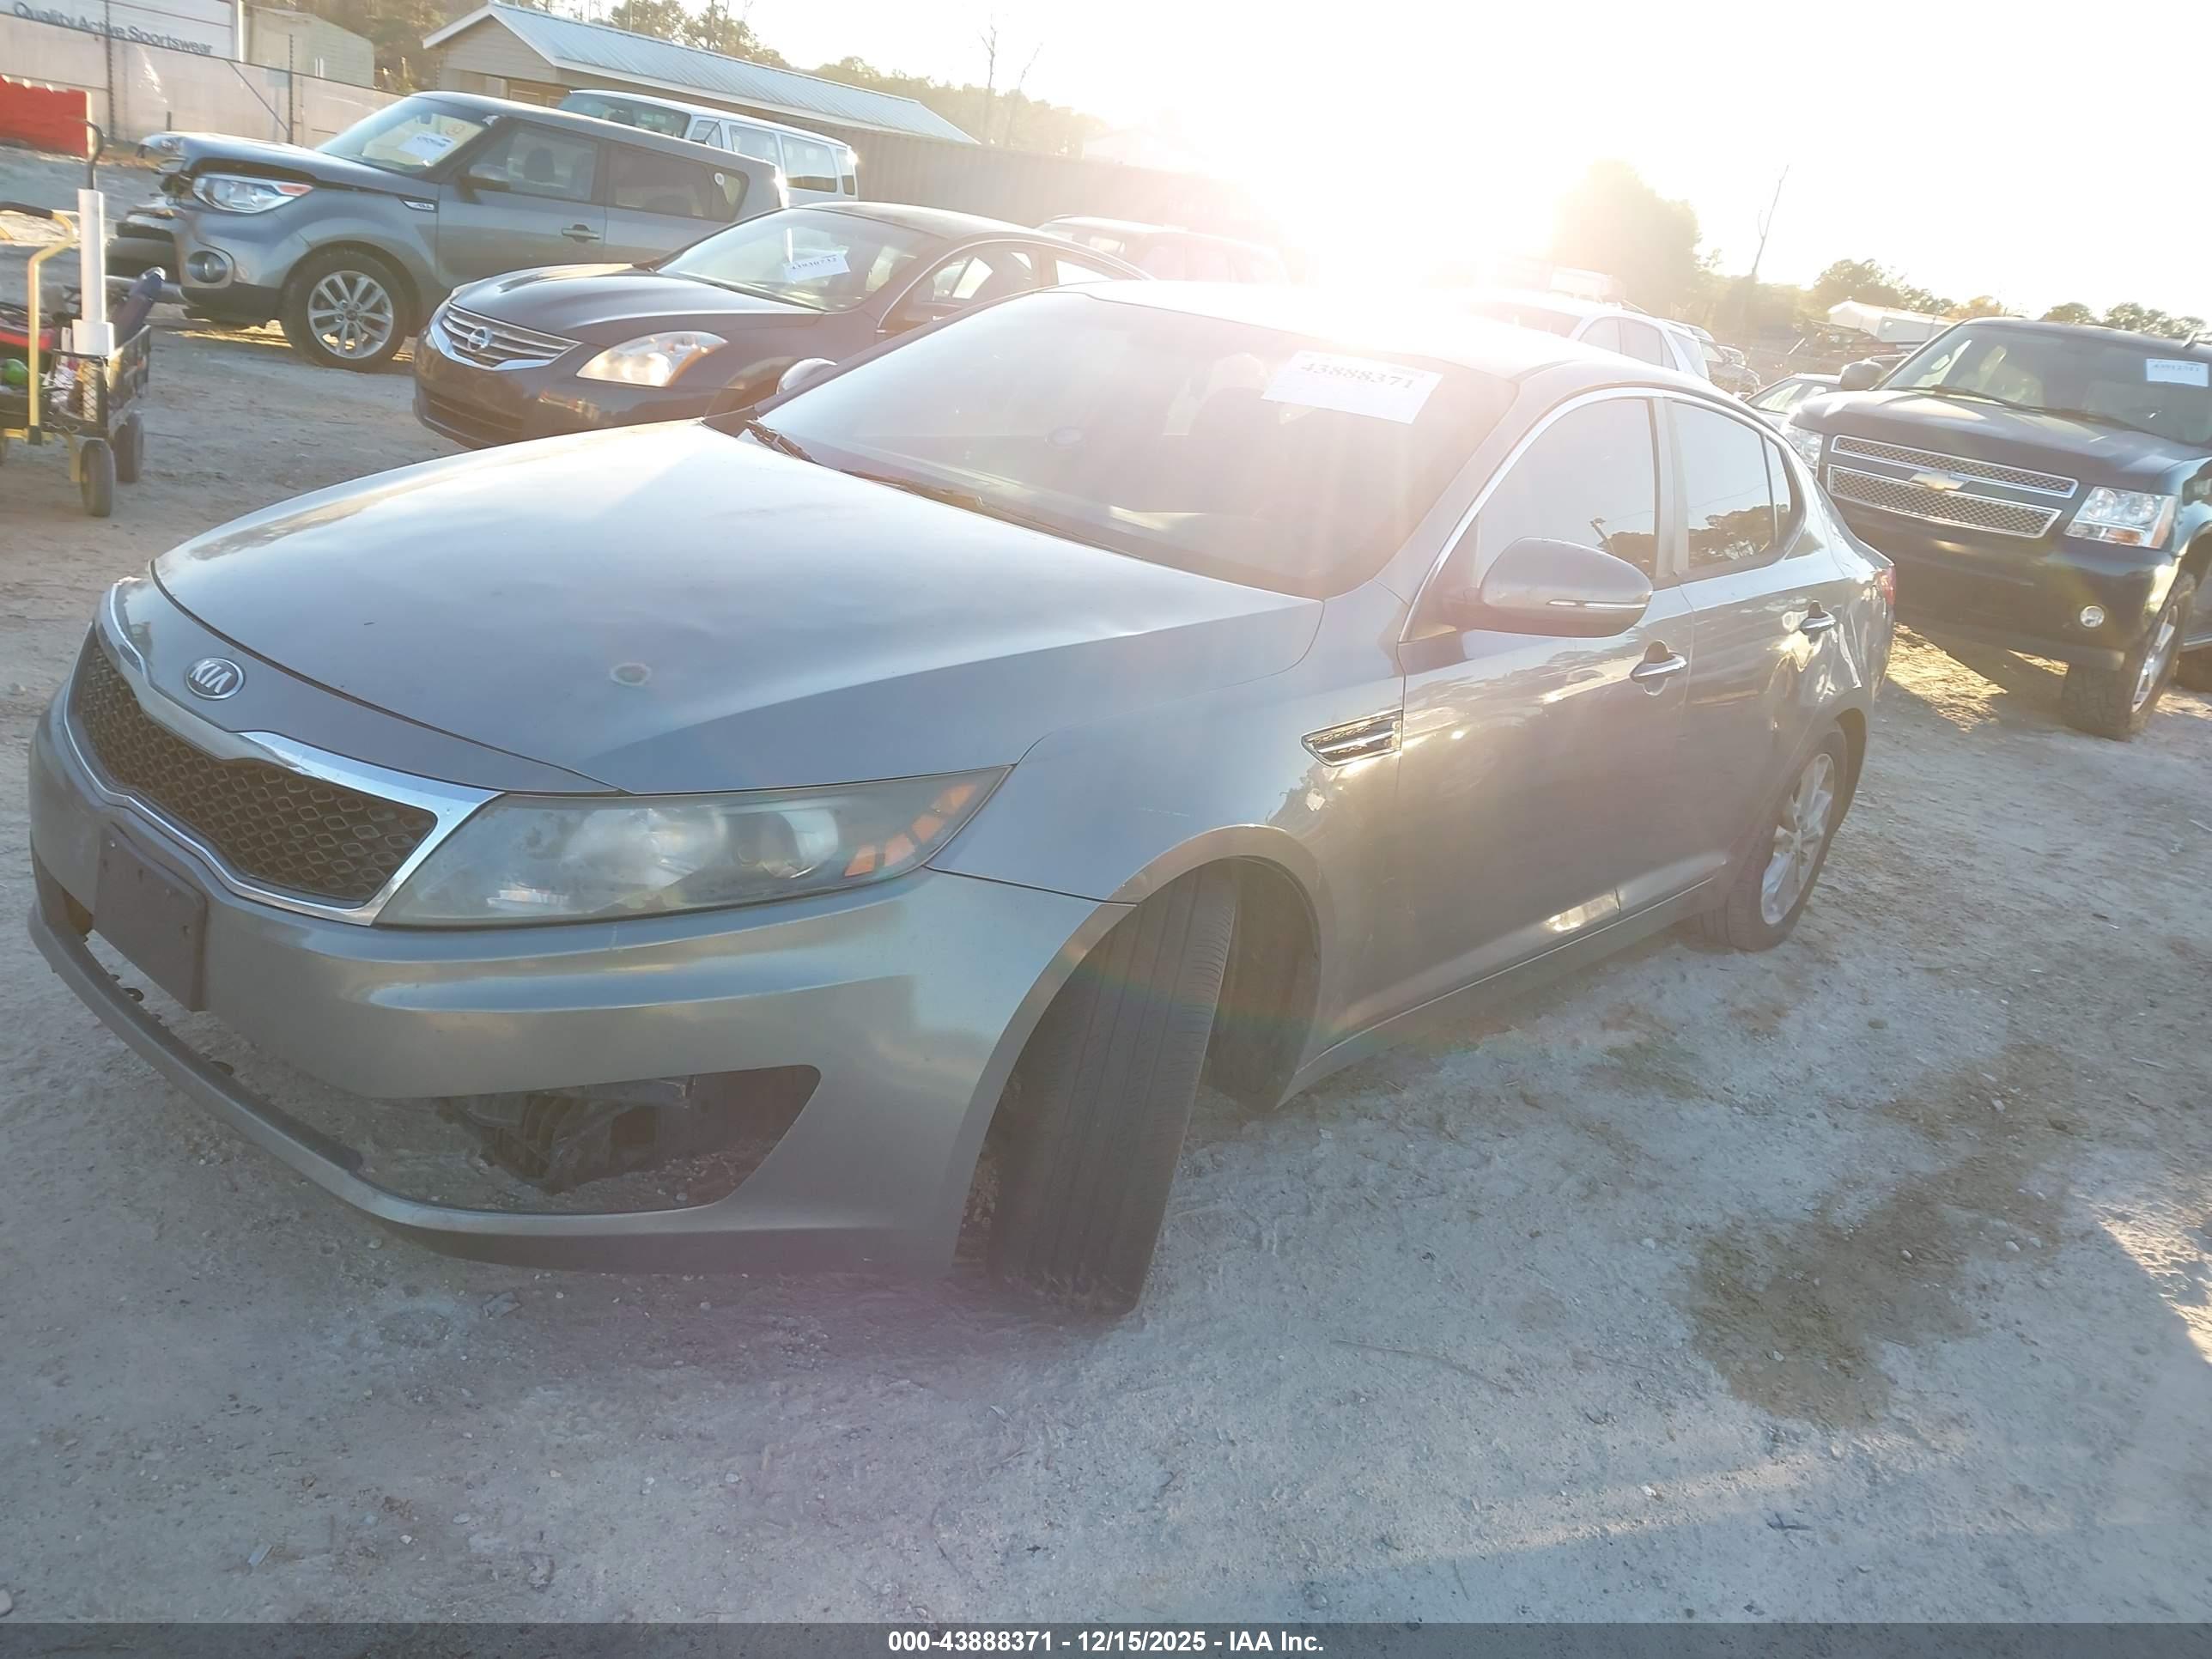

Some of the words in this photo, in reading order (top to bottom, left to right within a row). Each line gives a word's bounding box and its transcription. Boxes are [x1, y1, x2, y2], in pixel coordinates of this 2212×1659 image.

[14, 3, 76, 29] Quality
[78, 15, 125, 38] Active
[129, 25, 213, 54] Sportswear
[1301, 363, 1414, 388] 43888371
[189, 659, 234, 695] KIA
